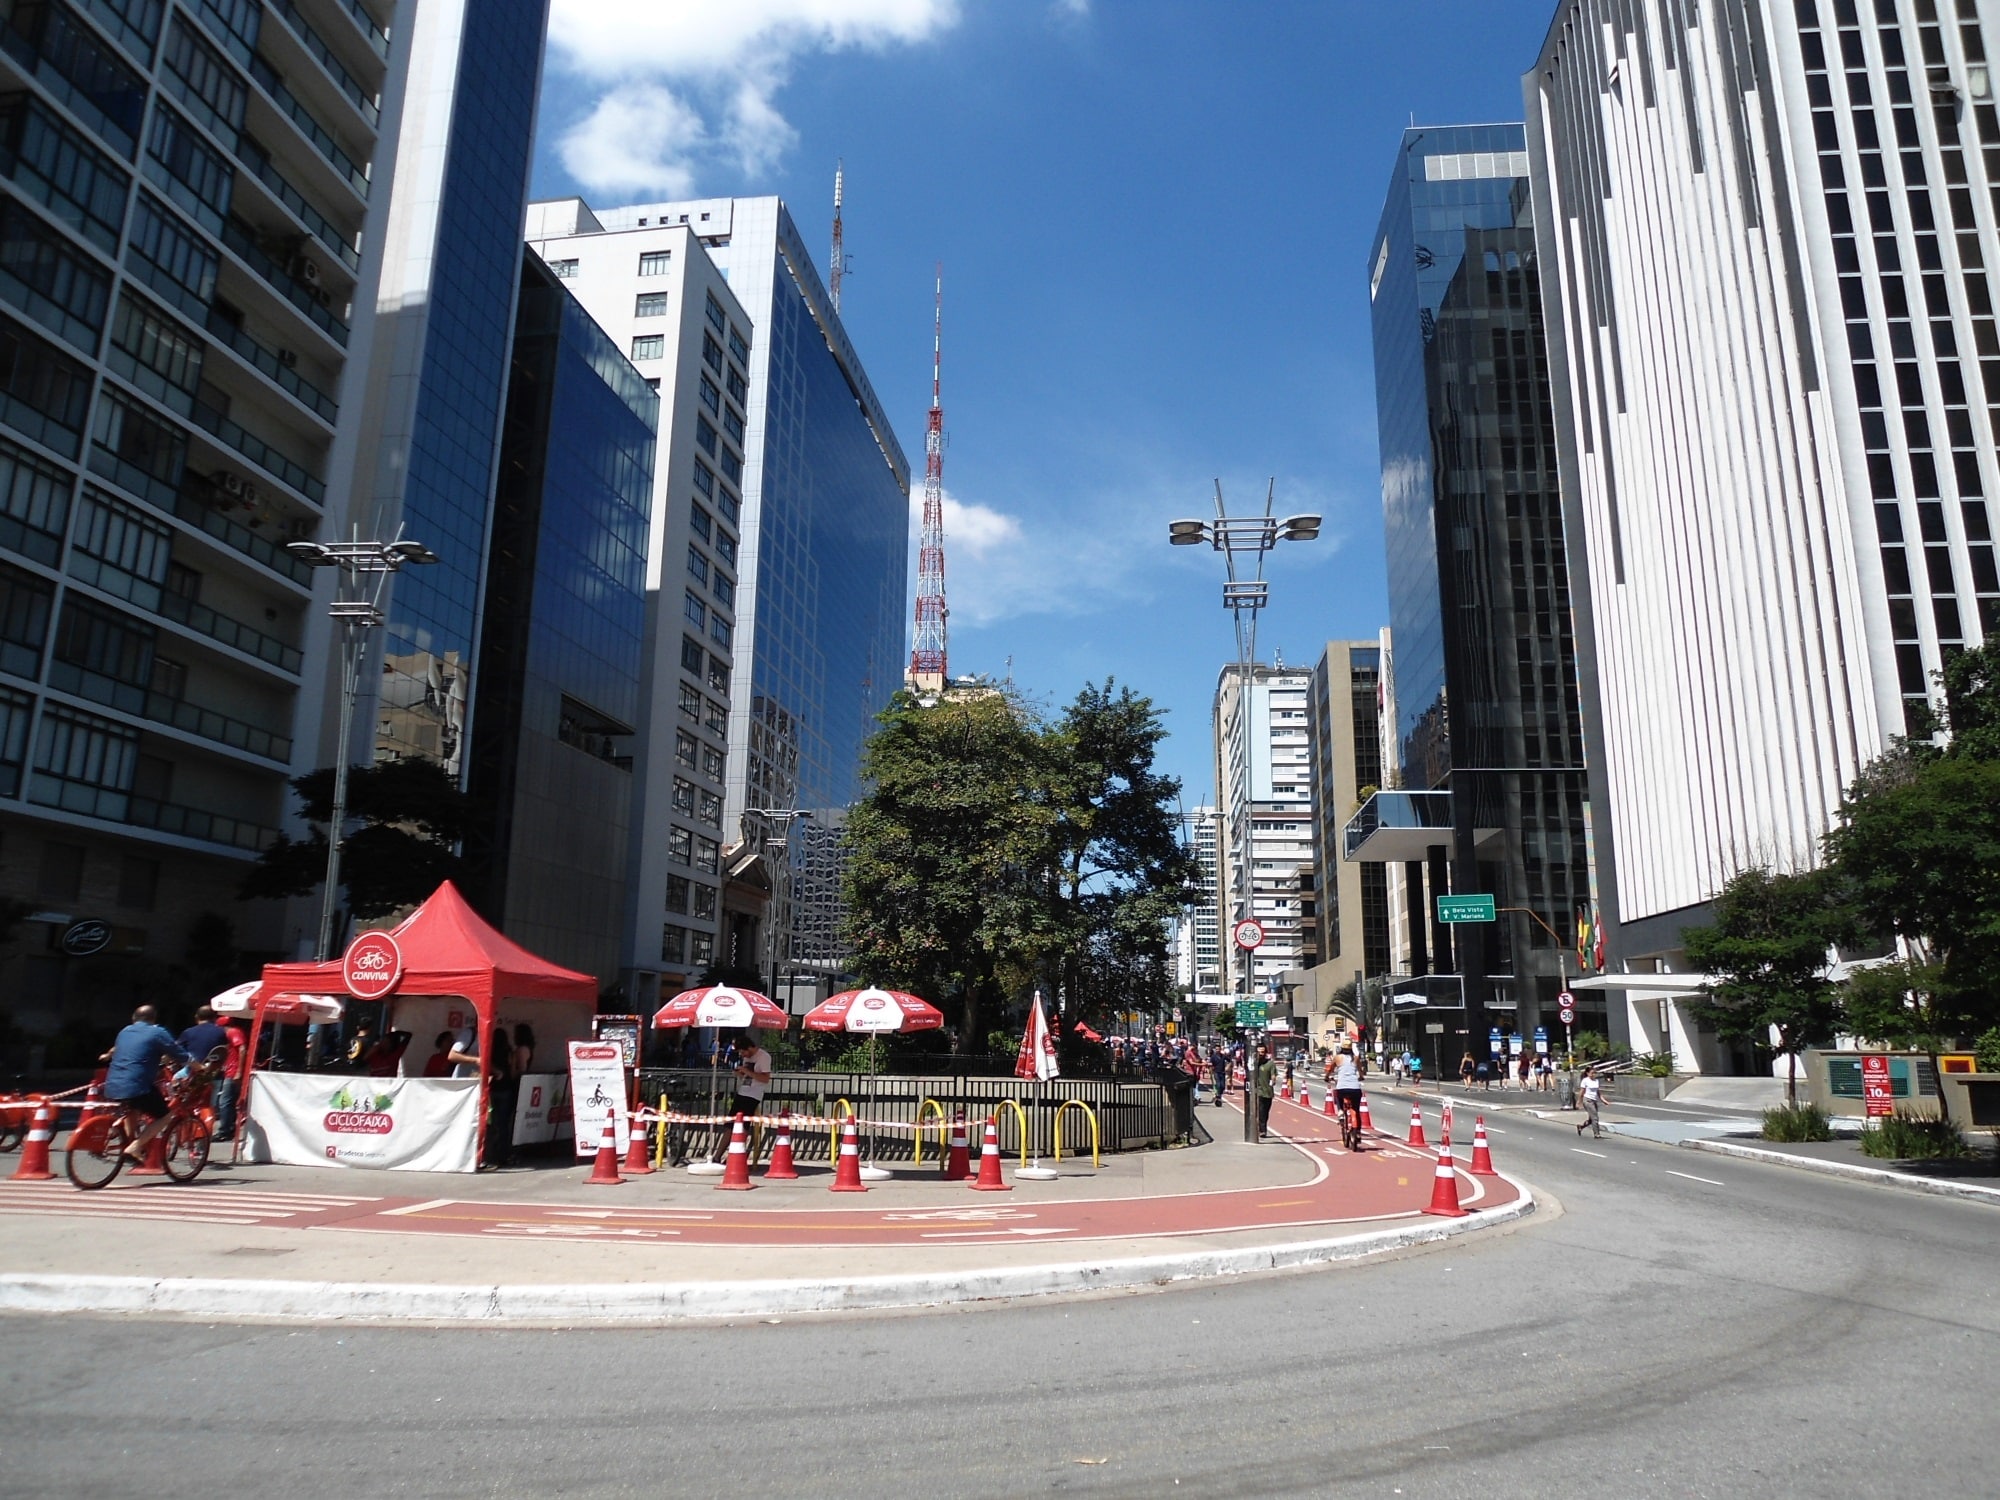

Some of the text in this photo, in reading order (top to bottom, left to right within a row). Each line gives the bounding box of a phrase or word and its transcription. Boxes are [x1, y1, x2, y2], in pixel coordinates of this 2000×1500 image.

[351, 971, 389, 981] CONVIVA
[1870, 1088, 1883, 1097] 10
[328, 1113, 388, 1128] CICLOFAIXA
